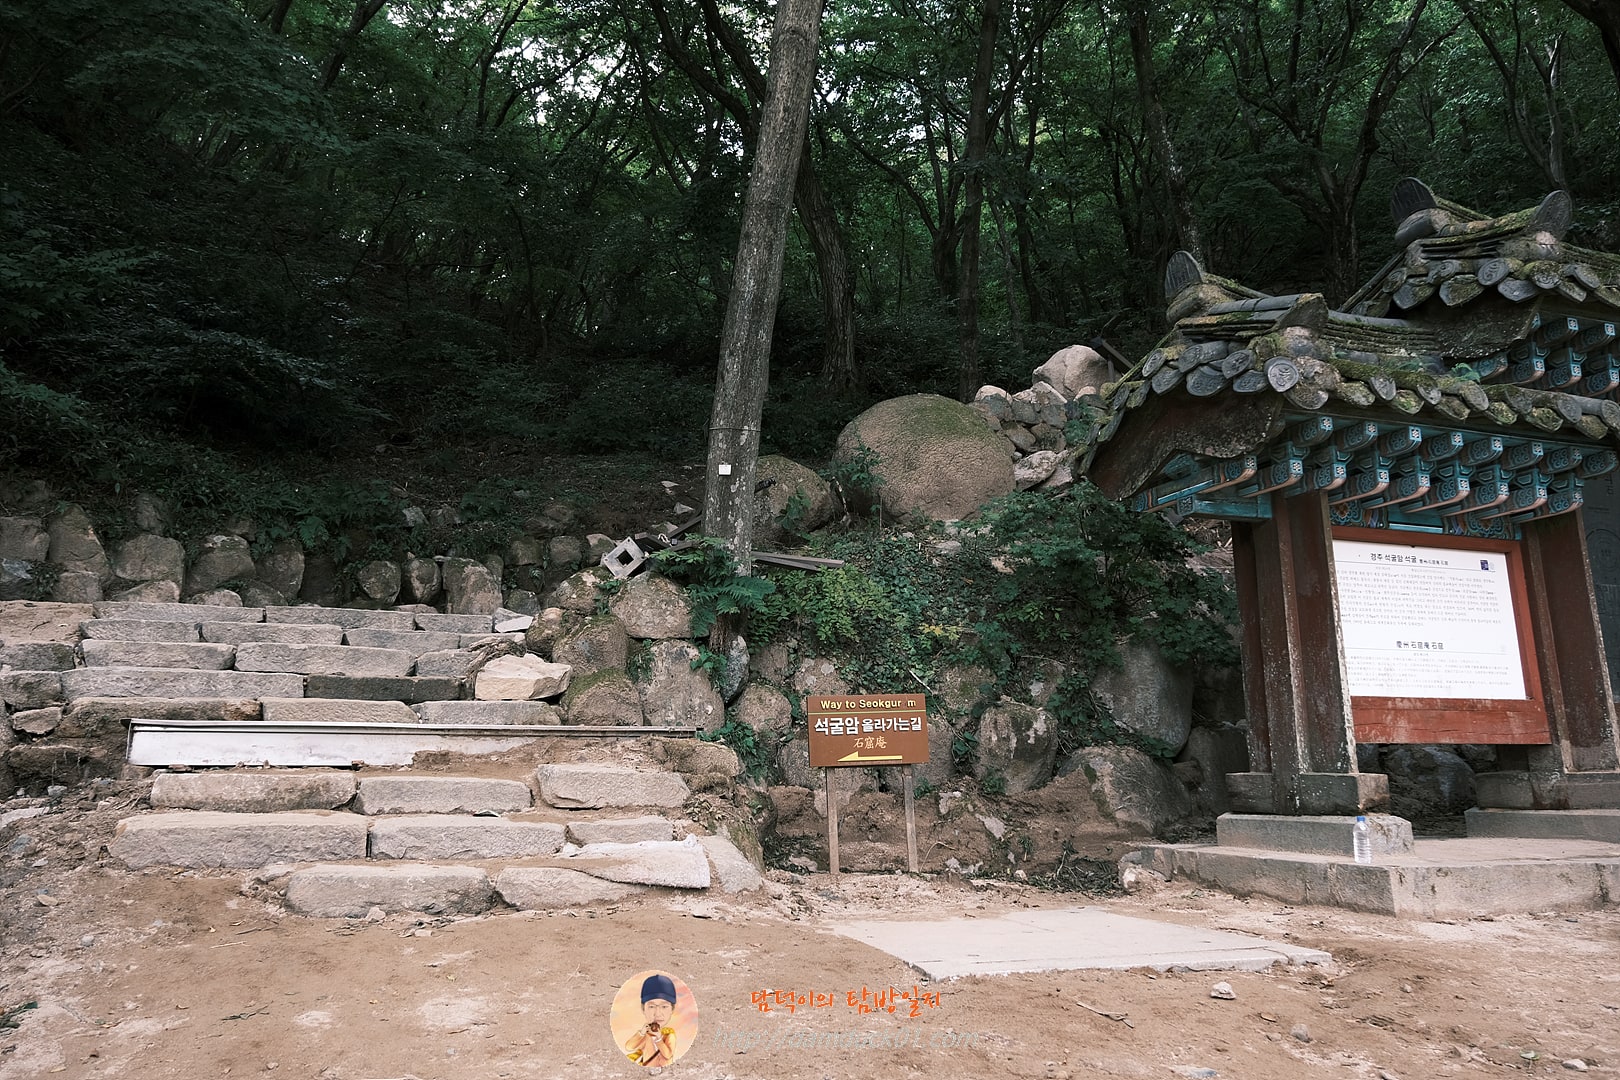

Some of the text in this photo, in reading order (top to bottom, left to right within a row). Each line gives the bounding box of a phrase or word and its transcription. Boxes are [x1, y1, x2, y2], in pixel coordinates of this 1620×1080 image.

[1370, 553, 1382, 562] 경주
[1384, 554, 1404, 563] 석굴암
[1405, 555, 1417, 564] 석굴
[820, 699, 916, 710] Way to Seokgurm
[814, 717, 922, 735] 석굴암 올라가는길
[853, 736, 887, 749] 石窟庵
